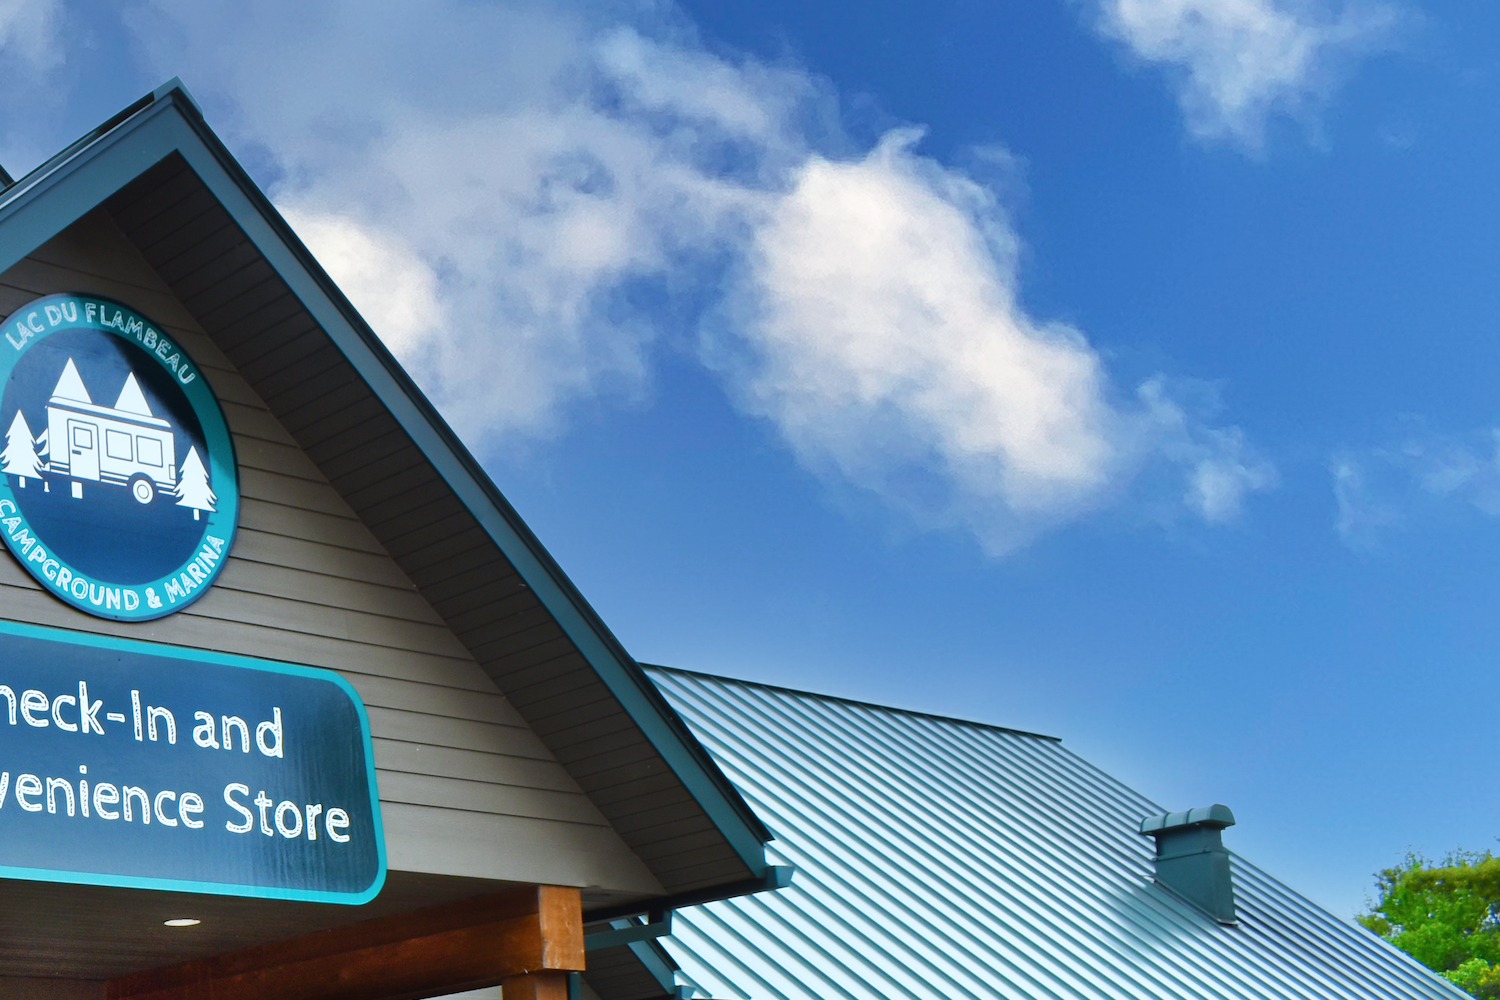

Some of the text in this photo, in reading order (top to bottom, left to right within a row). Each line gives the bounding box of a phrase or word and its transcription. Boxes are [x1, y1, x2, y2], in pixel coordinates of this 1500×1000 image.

[5, 302, 197, 385] LAC DU FLAMBEAU
[145, 587, 163, 609] &
[164, 534, 225, 604] MARINA
[192, 707, 284, 759] and
[223, 783, 351, 844] Store
